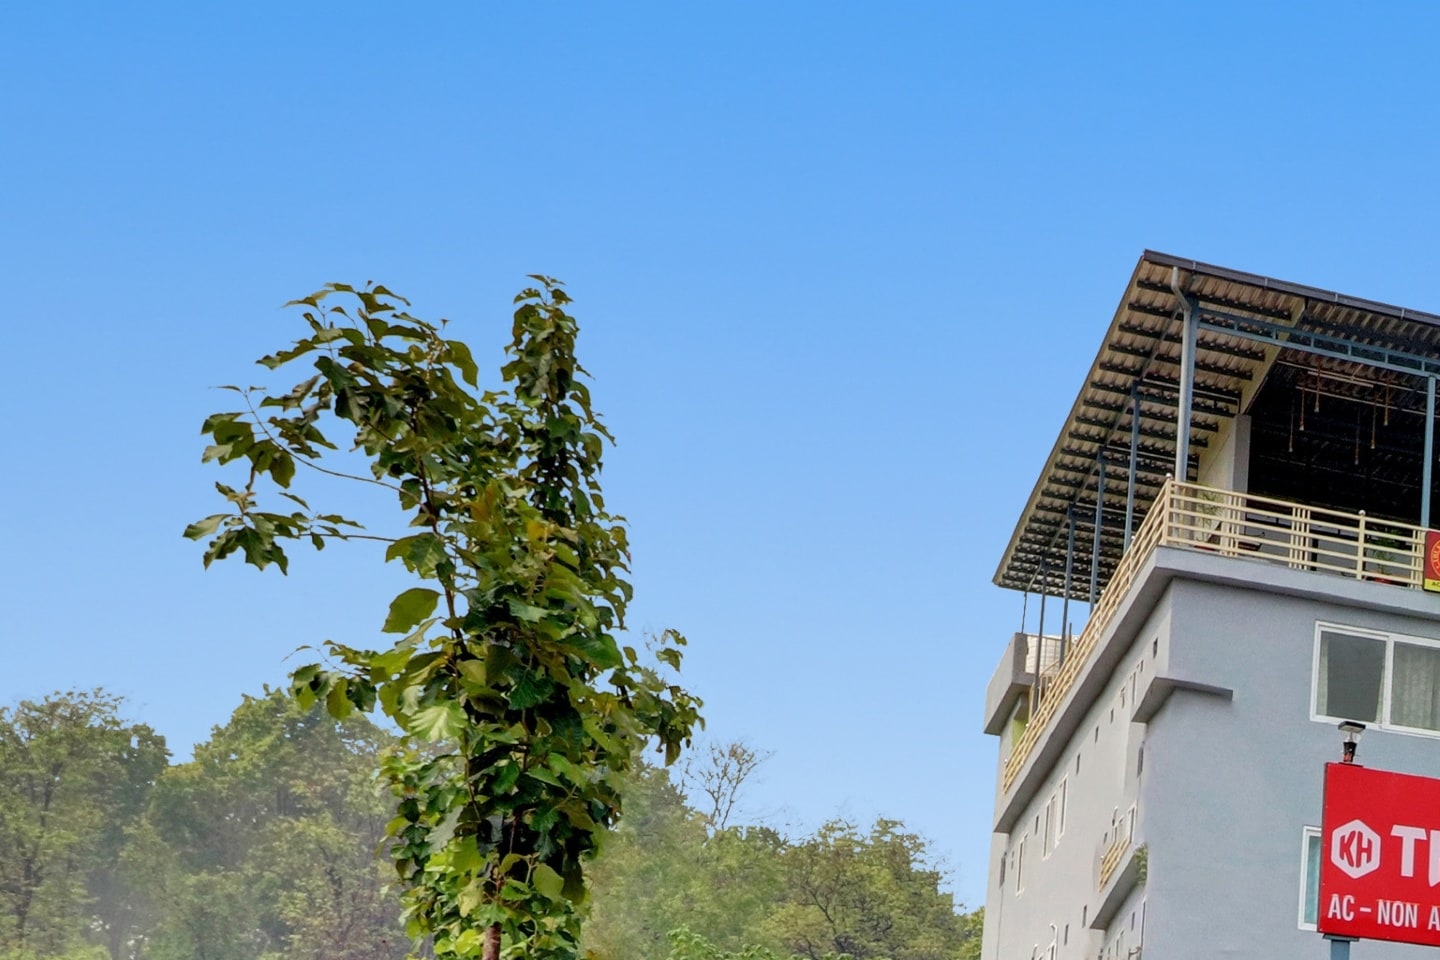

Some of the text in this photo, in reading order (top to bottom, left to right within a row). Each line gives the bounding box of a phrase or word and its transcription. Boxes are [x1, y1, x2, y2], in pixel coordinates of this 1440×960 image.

[1339, 830, 1373, 867] KH
[1328, 893, 1355, 922] AC
[1376, 900, 1418, 929] NON
